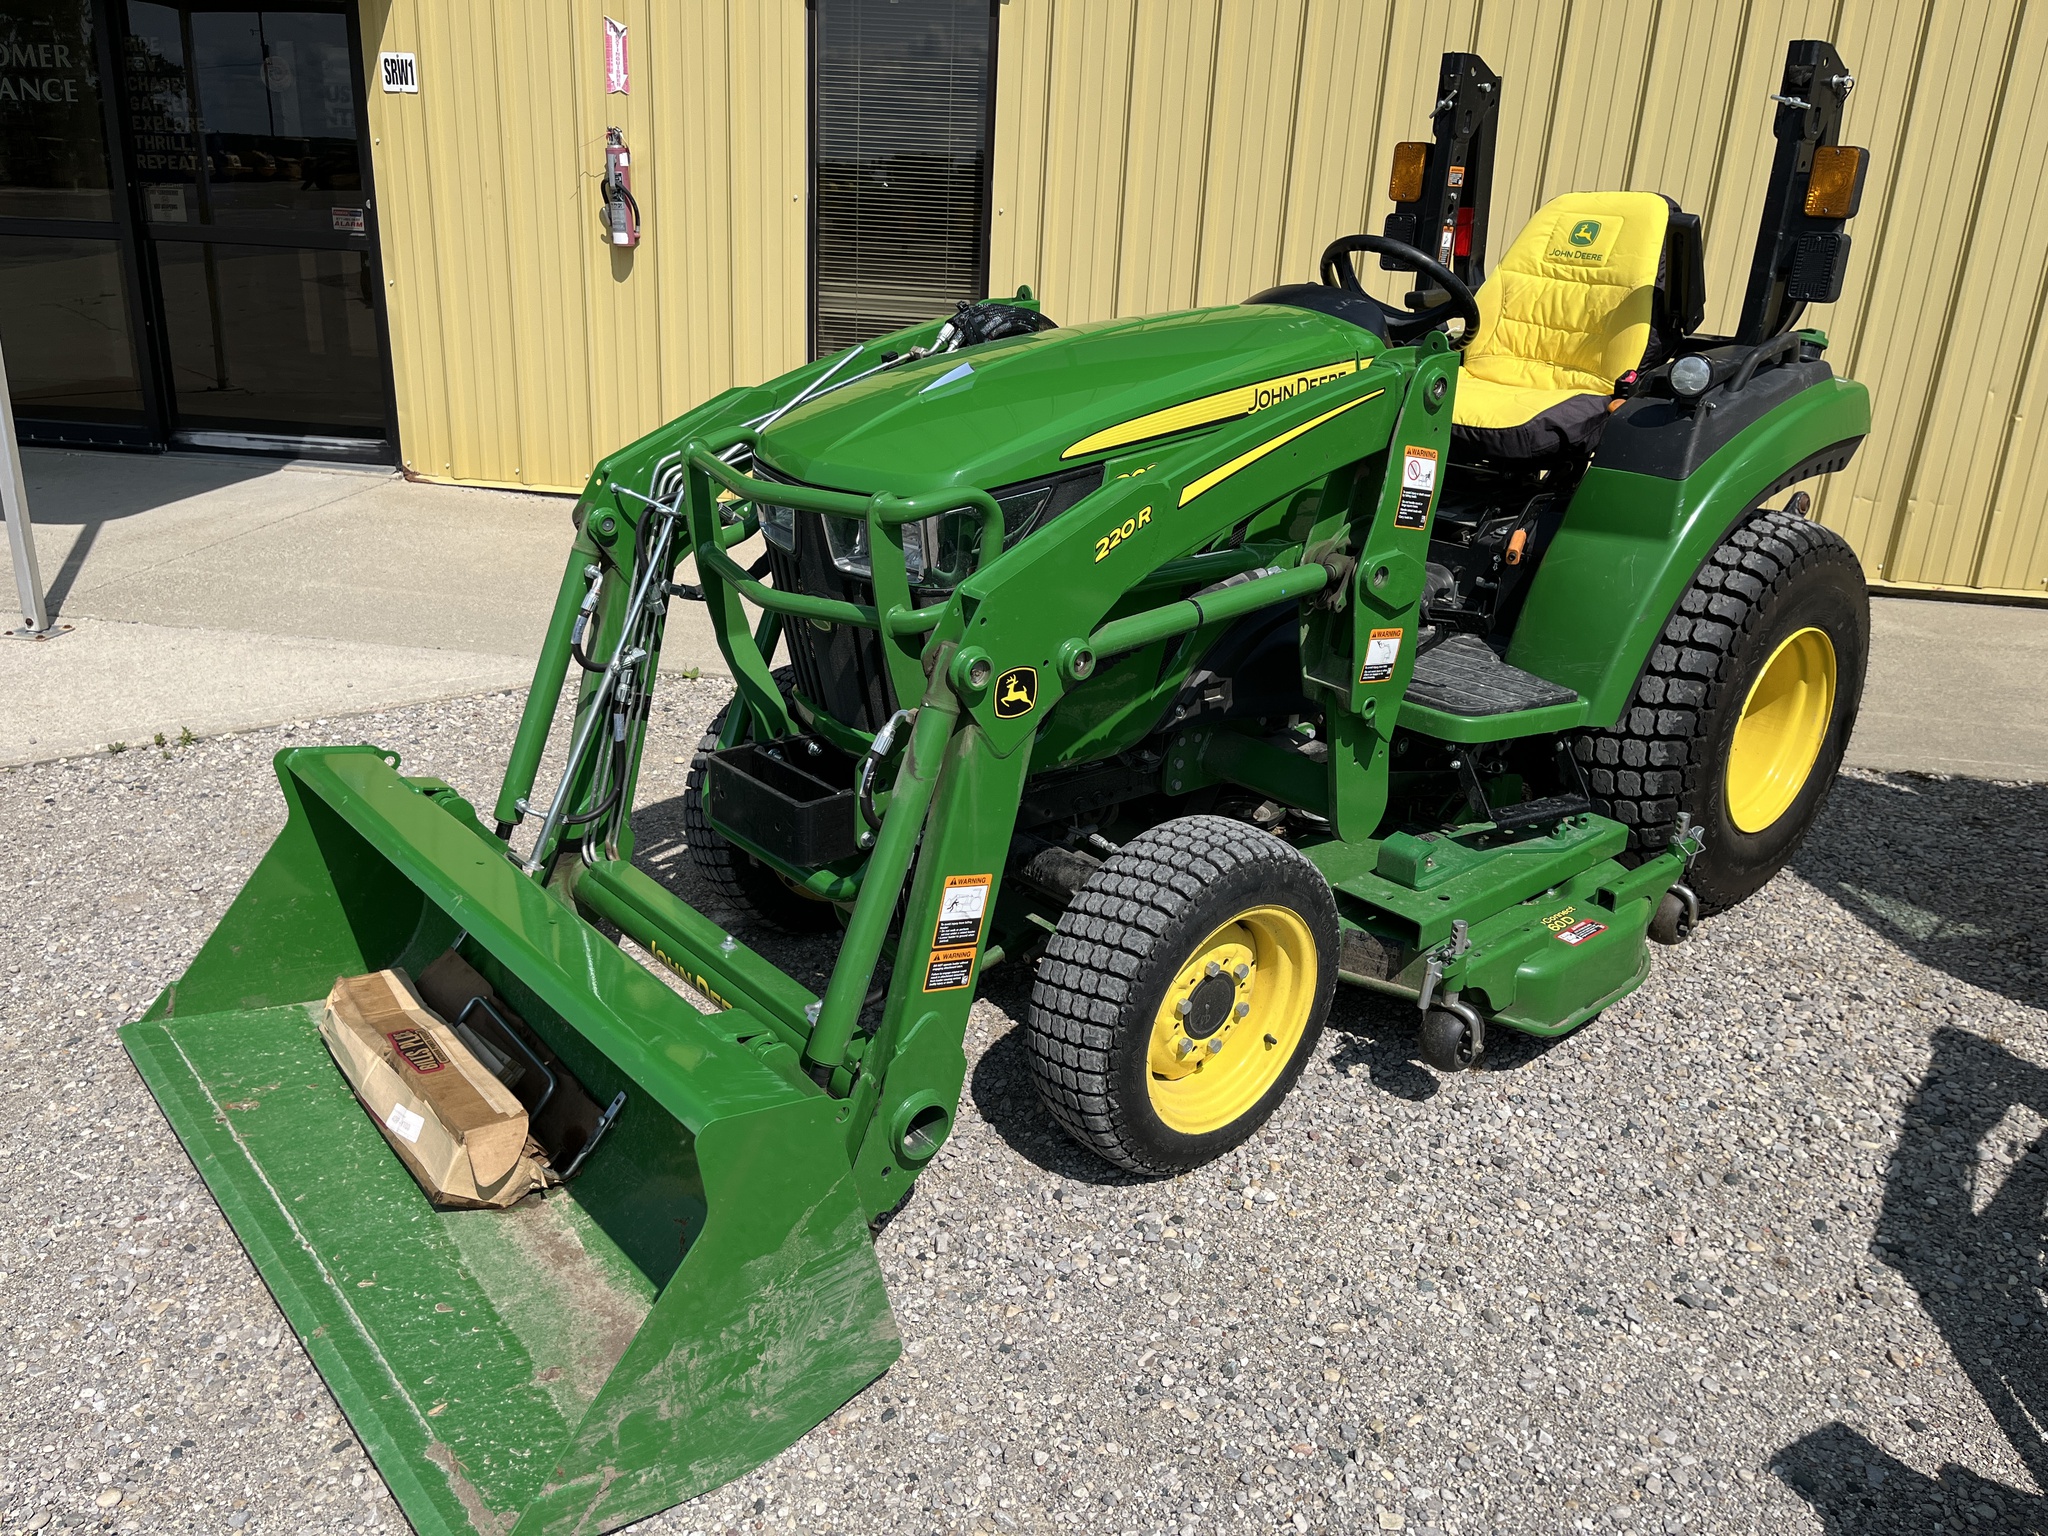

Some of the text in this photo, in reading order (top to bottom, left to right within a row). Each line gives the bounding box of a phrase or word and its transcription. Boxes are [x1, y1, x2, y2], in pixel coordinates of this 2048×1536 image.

[383, 58, 416, 87] SRW1
[0, 77, 80, 102] ANCE
[1549, 248, 1603, 262] JOHN DEERE
[1247, 383, 1294, 412] JOHN
[1411, 449, 1436, 459] WARNING
[1377, 630, 1401, 638] WARNING
[957, 877, 987, 885] WARNING
[1547, 915, 1576, 932] 60D
[943, 951, 971, 960] WARNING
